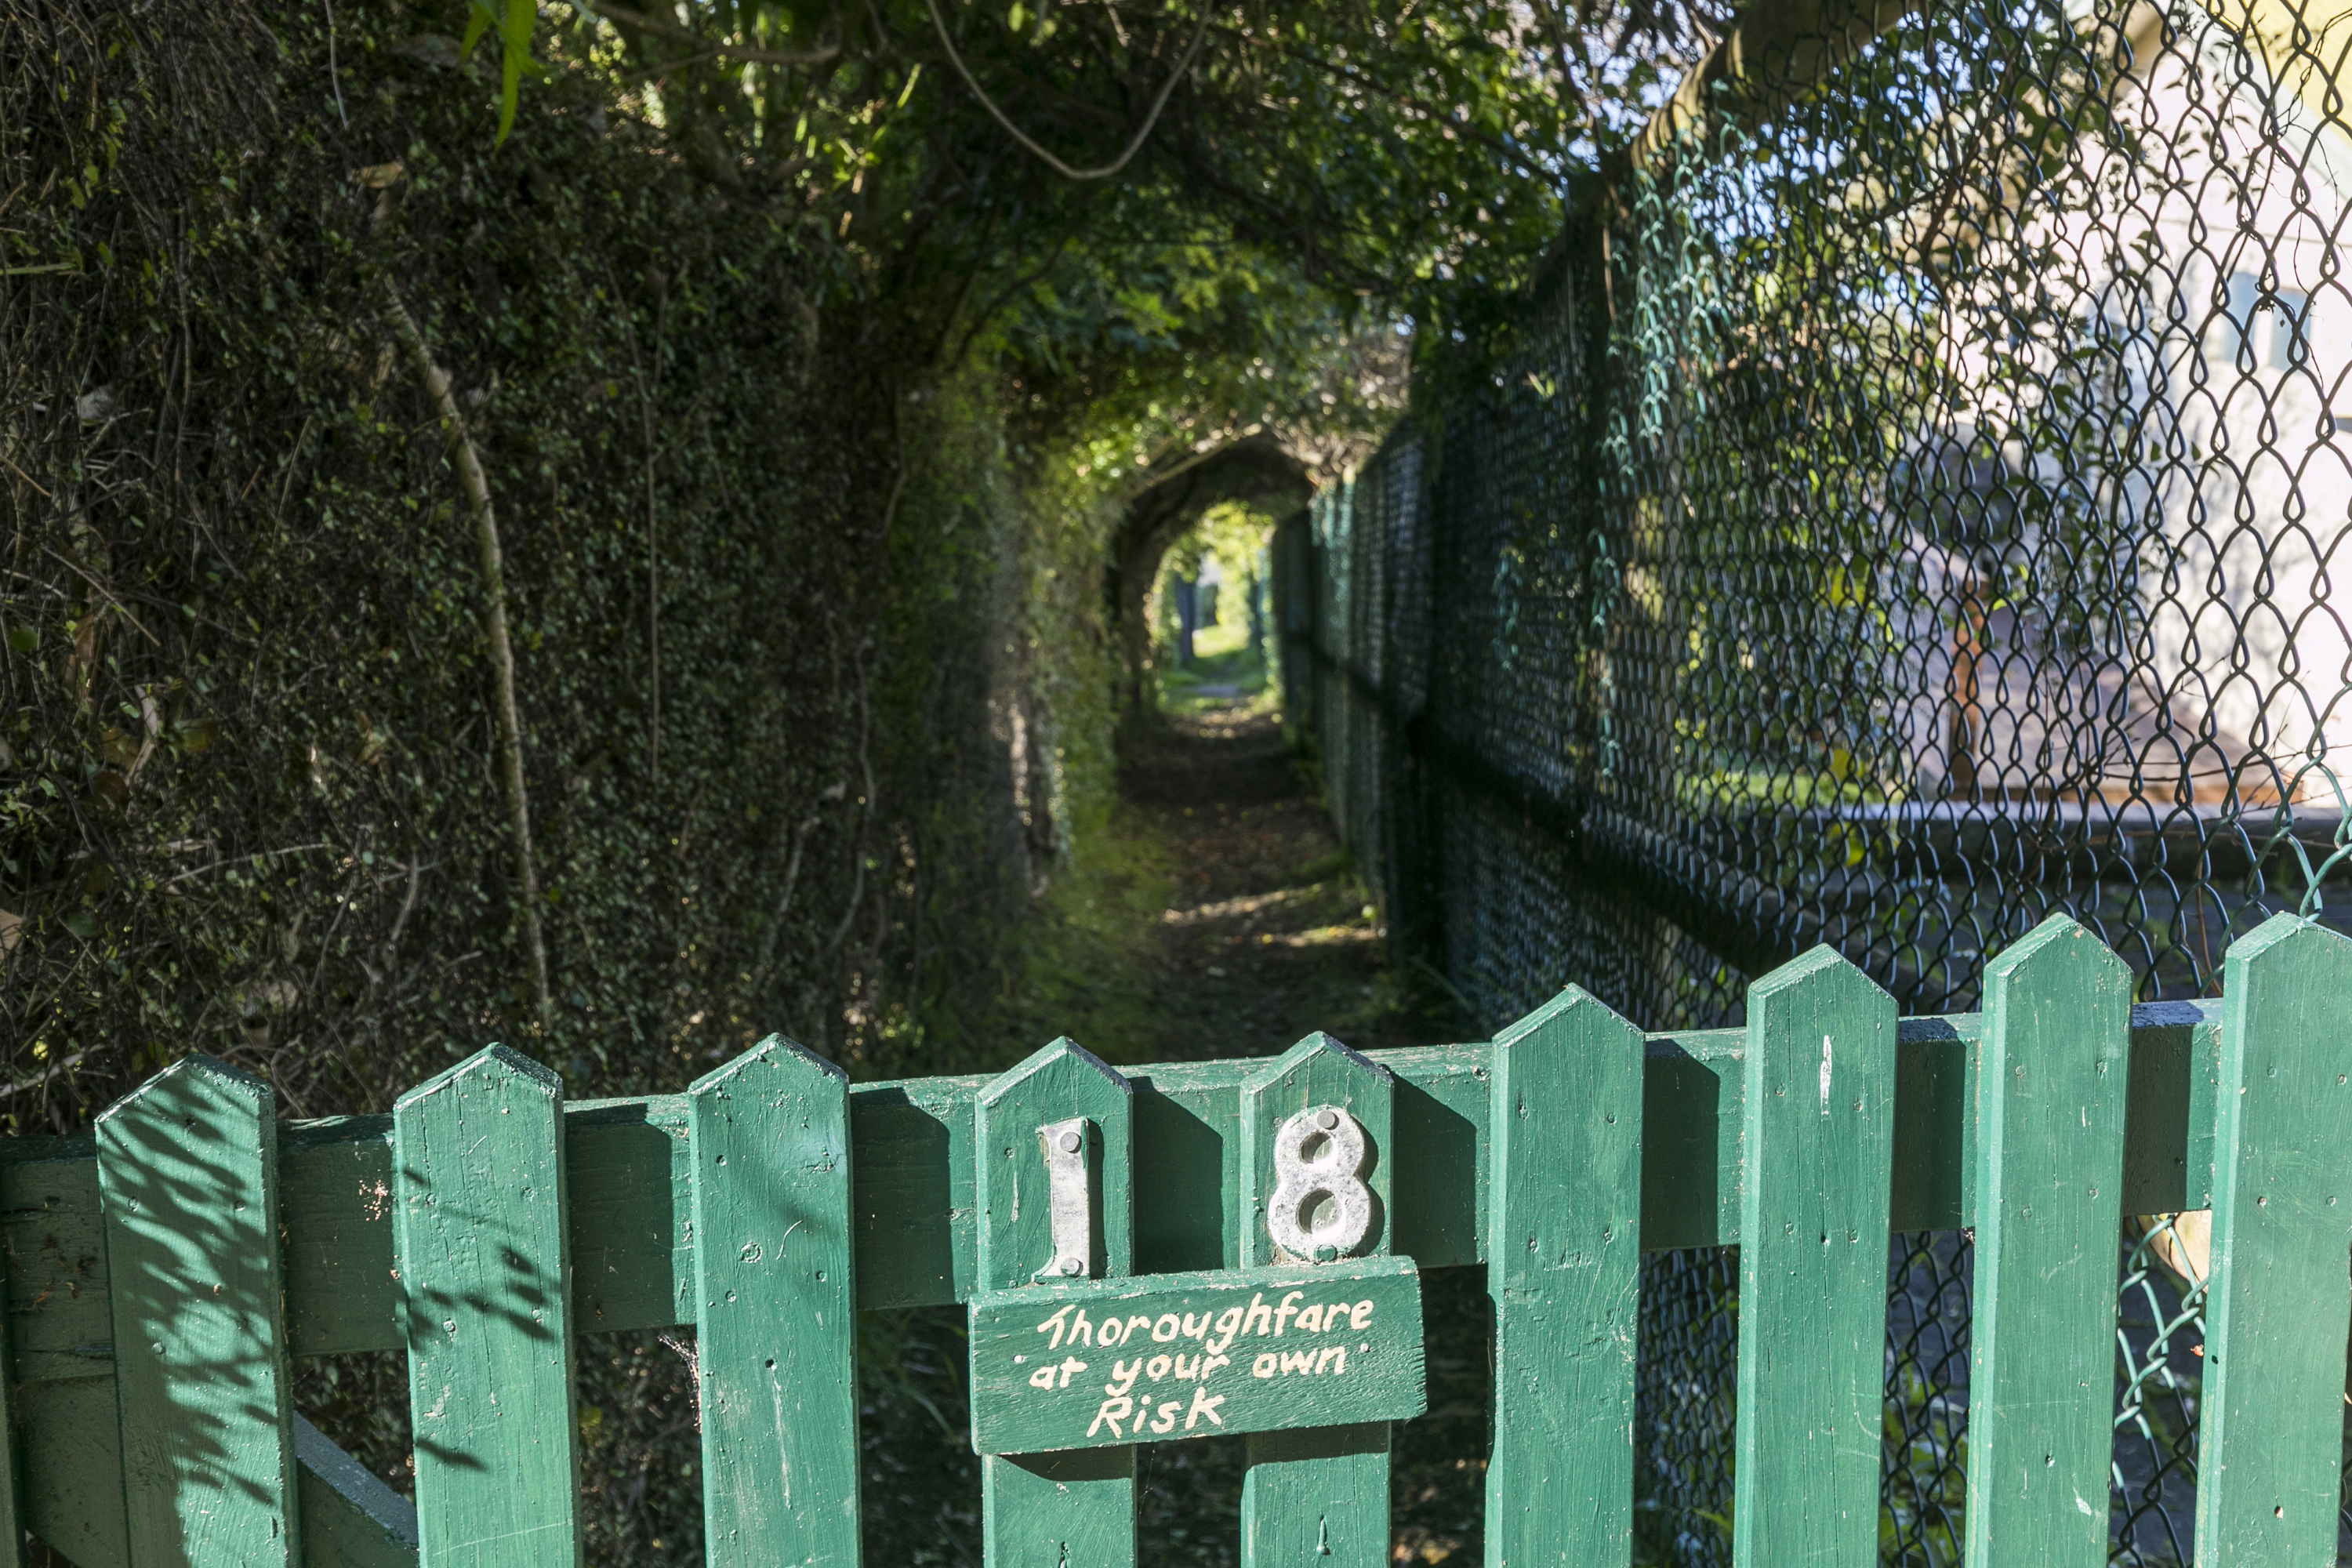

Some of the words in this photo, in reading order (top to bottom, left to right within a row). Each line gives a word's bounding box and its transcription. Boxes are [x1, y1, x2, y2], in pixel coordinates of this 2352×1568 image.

[1036, 1290, 1374, 1355] Thoroughfare
[1028, 1356, 1088, 1391] at
[1105, 1352, 1231, 1397] your
[1252, 1345, 1346, 1379] own
[1086, 1386, 1225, 1439] Risk
